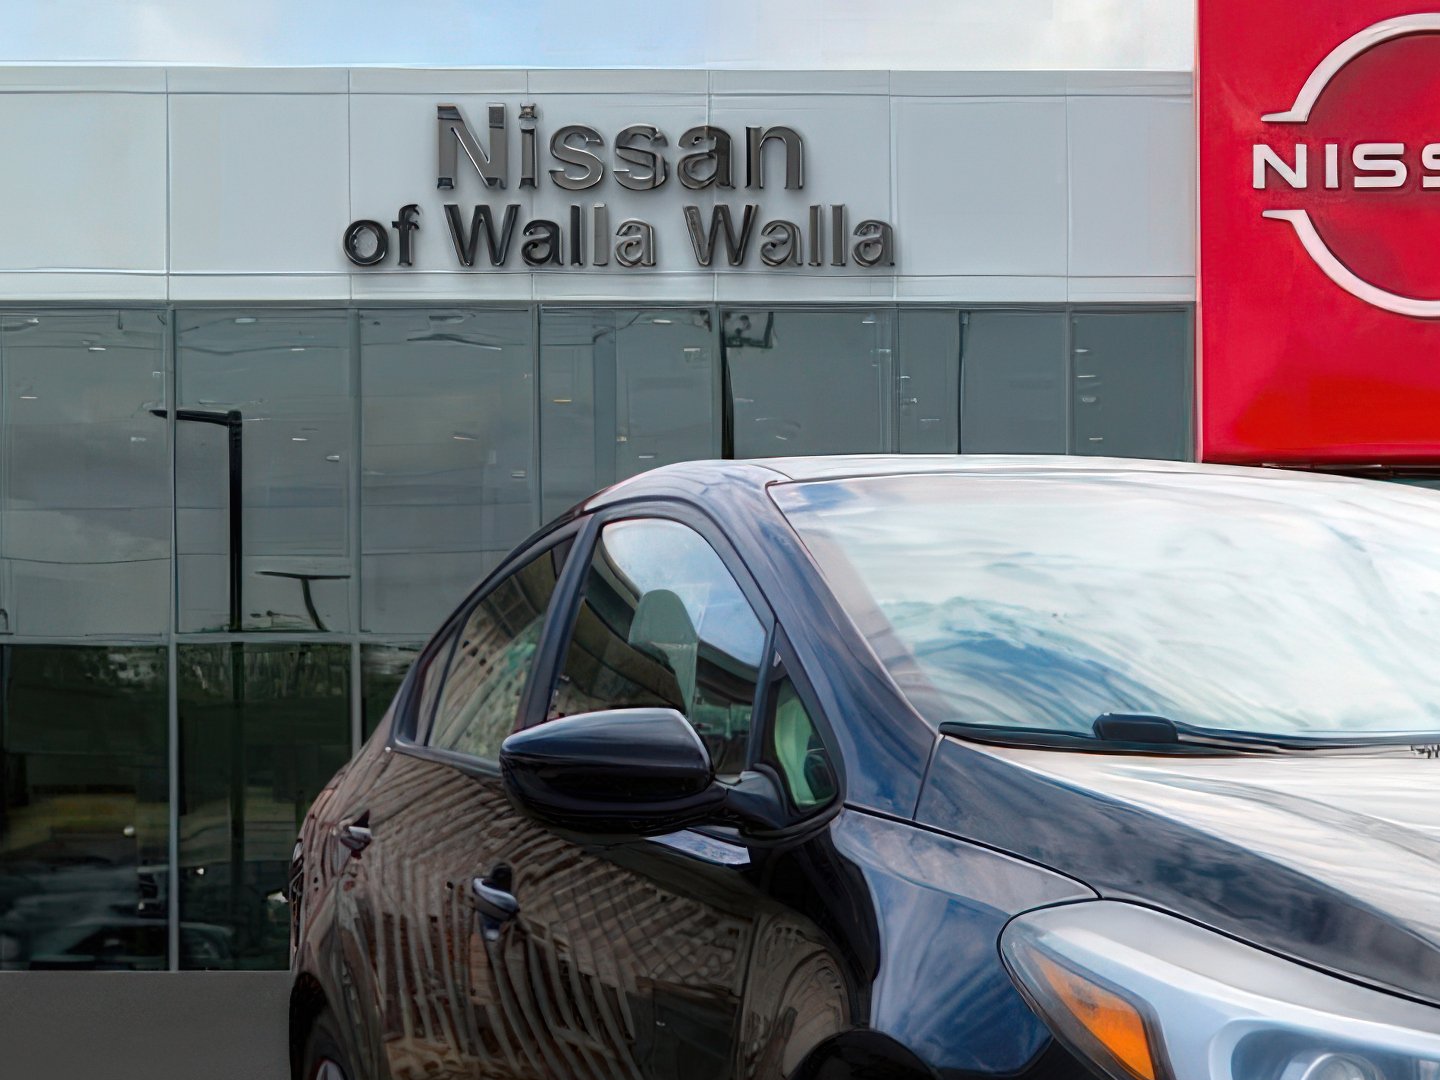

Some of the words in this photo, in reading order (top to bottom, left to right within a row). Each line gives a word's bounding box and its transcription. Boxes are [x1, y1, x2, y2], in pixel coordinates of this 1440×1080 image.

[436, 102, 804, 190] Nissan
[343, 204, 422, 266] of
[443, 204, 657, 267] Walla
[683, 204, 895, 267] Walla
